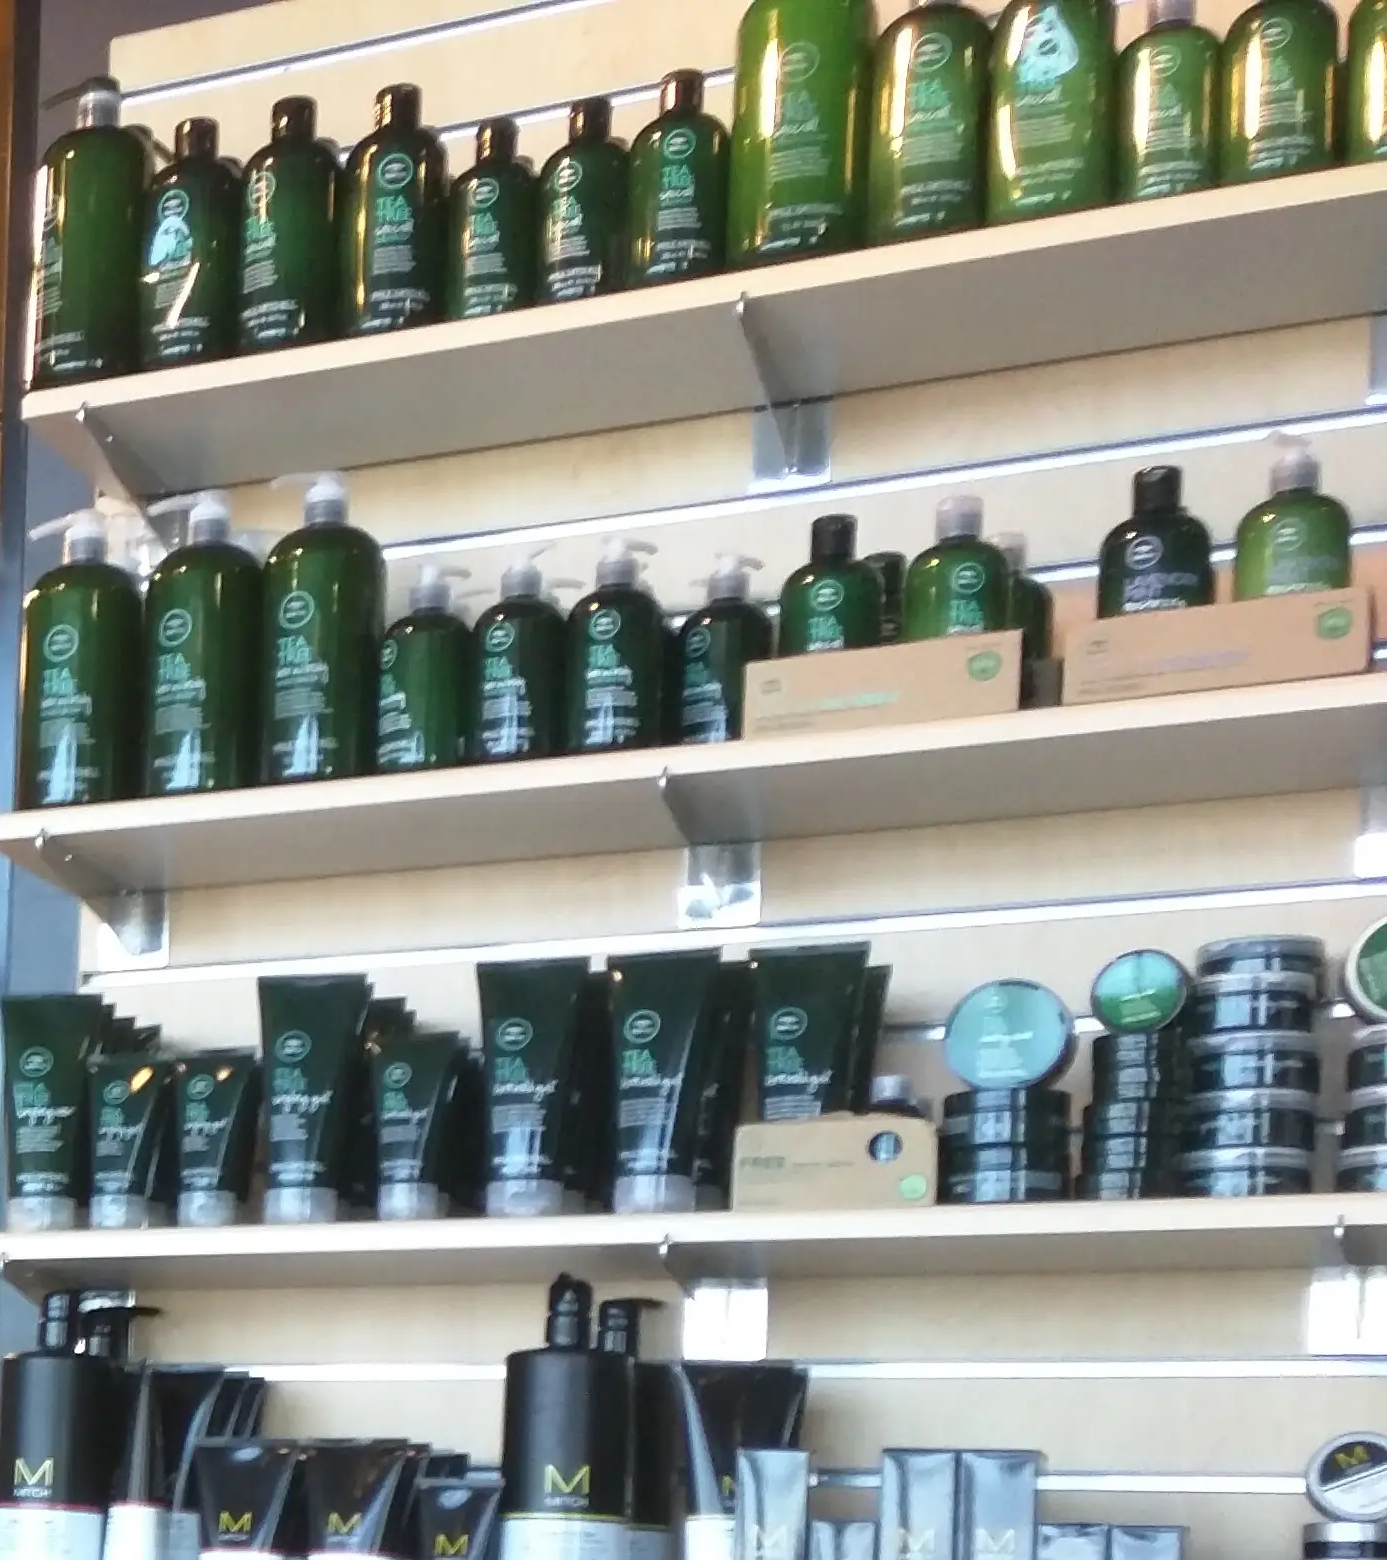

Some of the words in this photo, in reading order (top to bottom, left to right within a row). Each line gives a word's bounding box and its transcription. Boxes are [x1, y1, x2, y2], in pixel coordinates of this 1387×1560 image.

[14, 1457, 54, 1486] M
[544, 1464, 591, 1493] M
[219, 1511, 252, 1533] M
[328, 1512, 362, 1534] M
[434, 1534, 468, 1556] M
